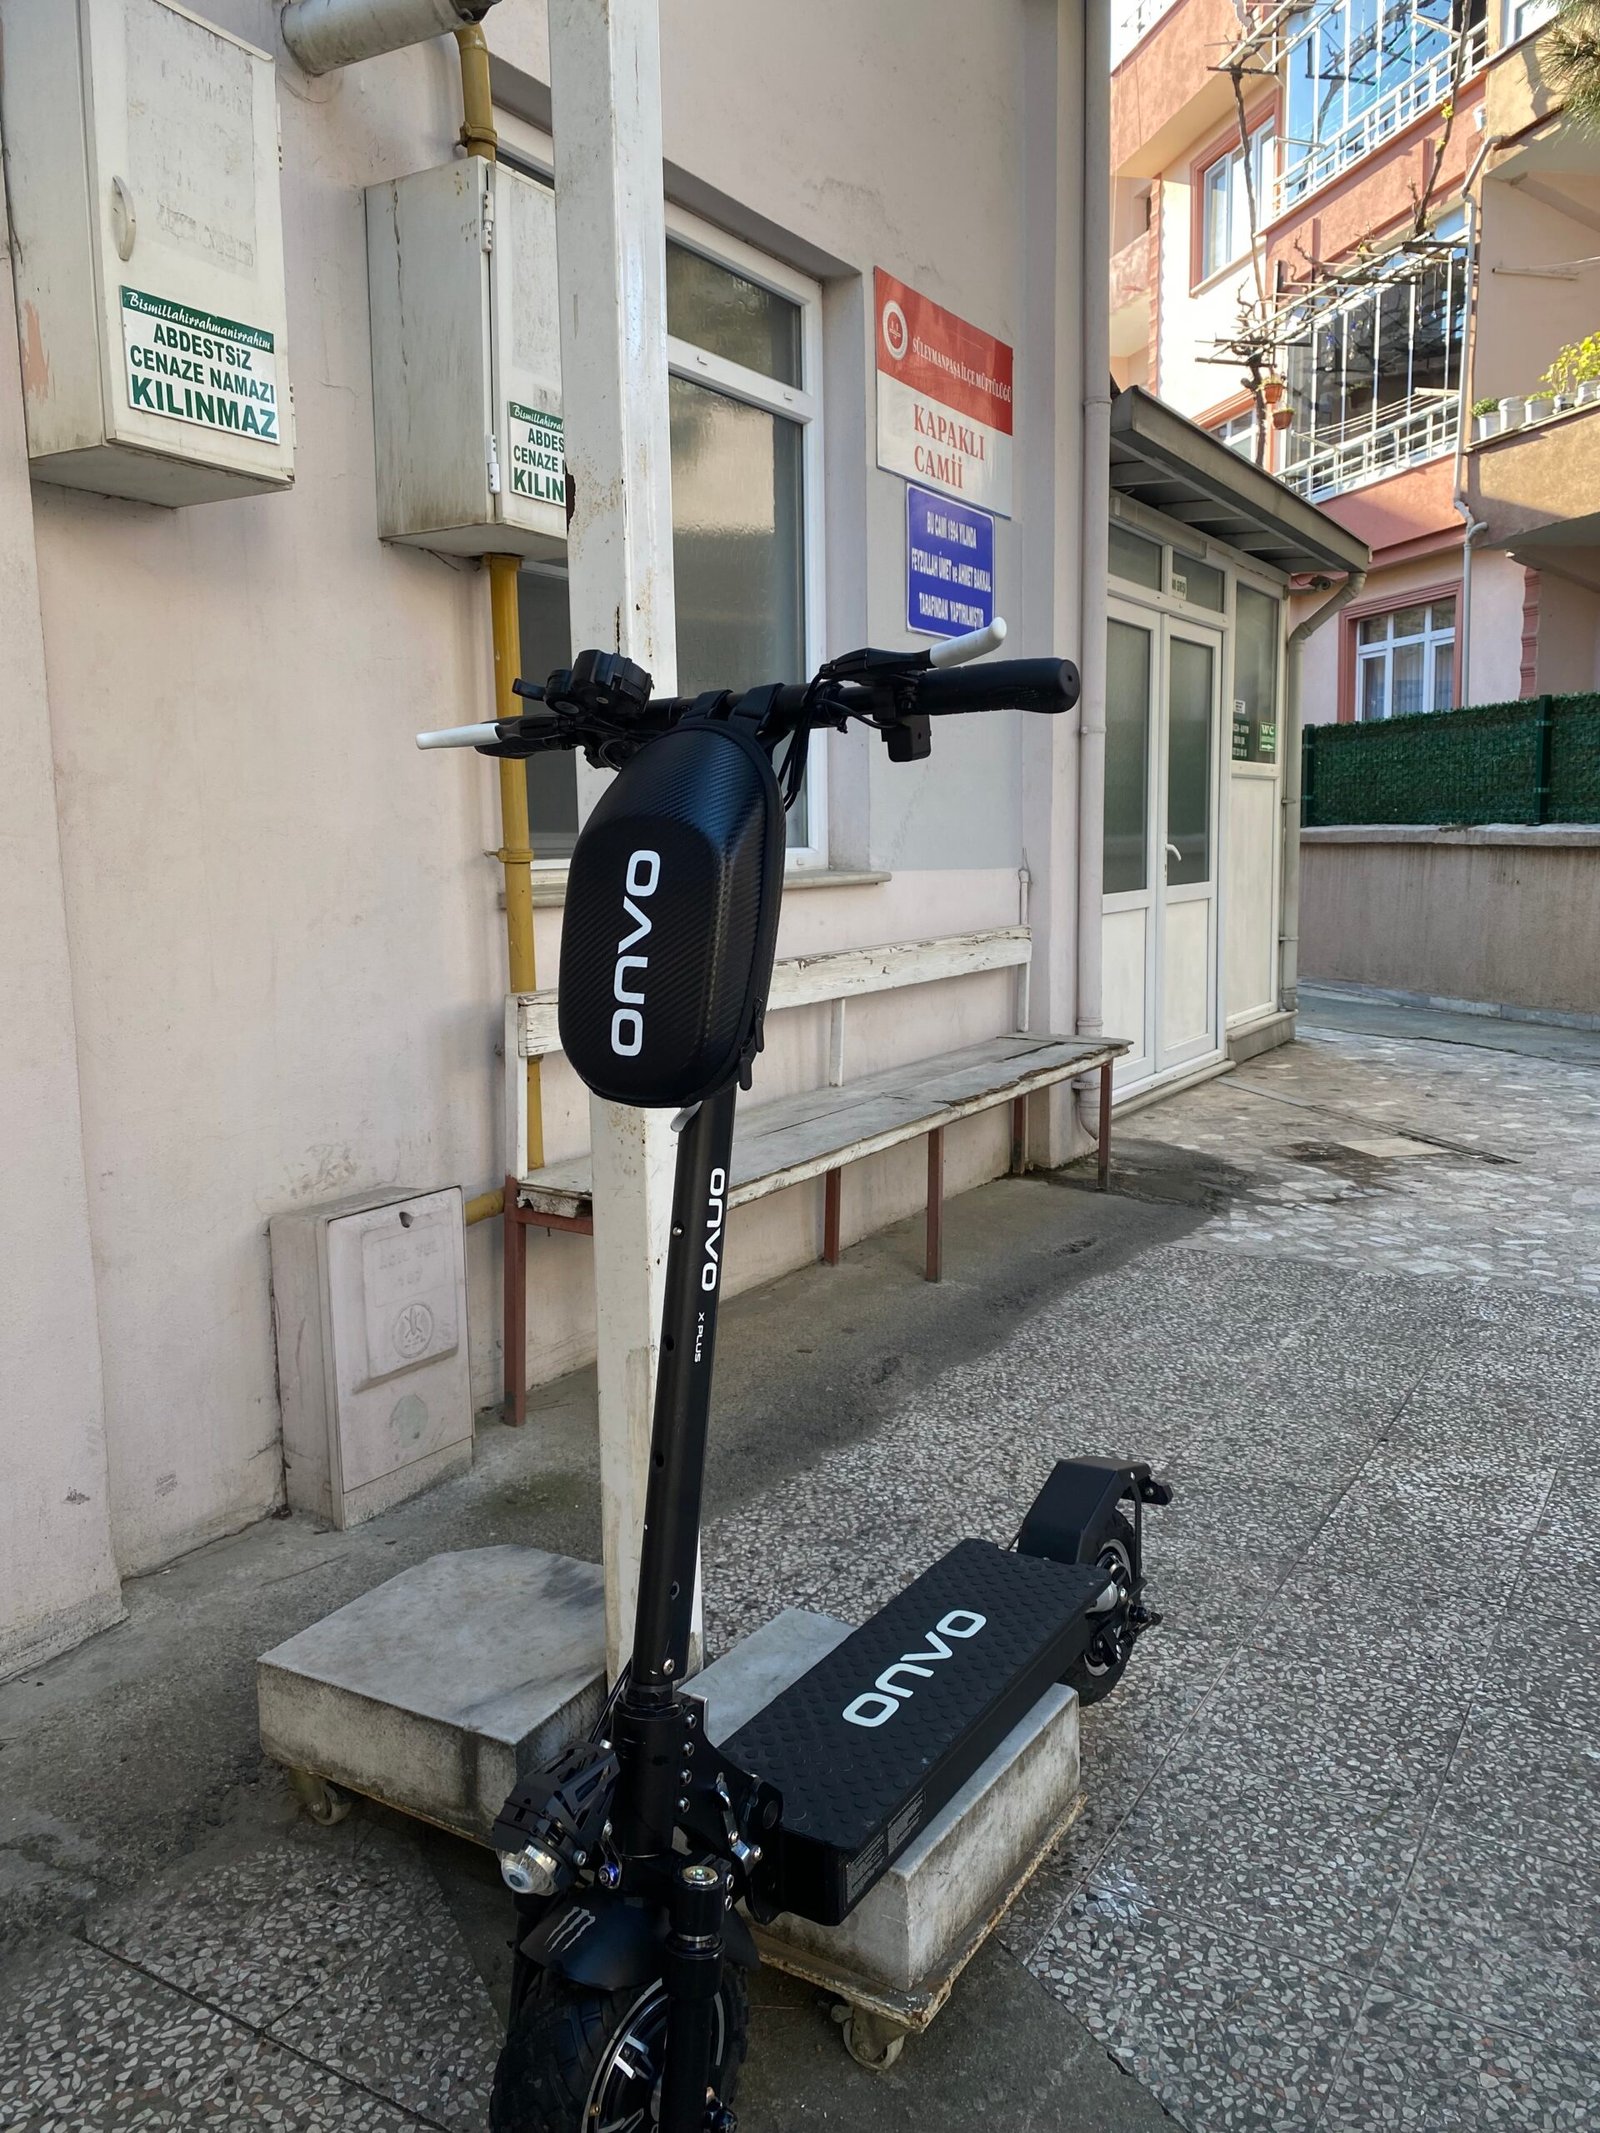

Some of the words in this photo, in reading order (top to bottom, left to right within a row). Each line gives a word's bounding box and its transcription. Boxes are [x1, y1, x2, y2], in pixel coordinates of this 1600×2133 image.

[126, 291, 271, 350] Bismillahirrahmanirrahim
[130, 345, 205, 385] CENAZE
[209, 367, 275, 404] NAMAZI
[131, 374, 277, 440] KILINMAZ
[913, 403, 985, 461] KAPAKLI
[513, 444, 559, 473] CENAZE
[1261, 724, 1275, 735] WC
[698, 1311, 705, 1322] X
[694, 1325, 704, 1363] PLUS
